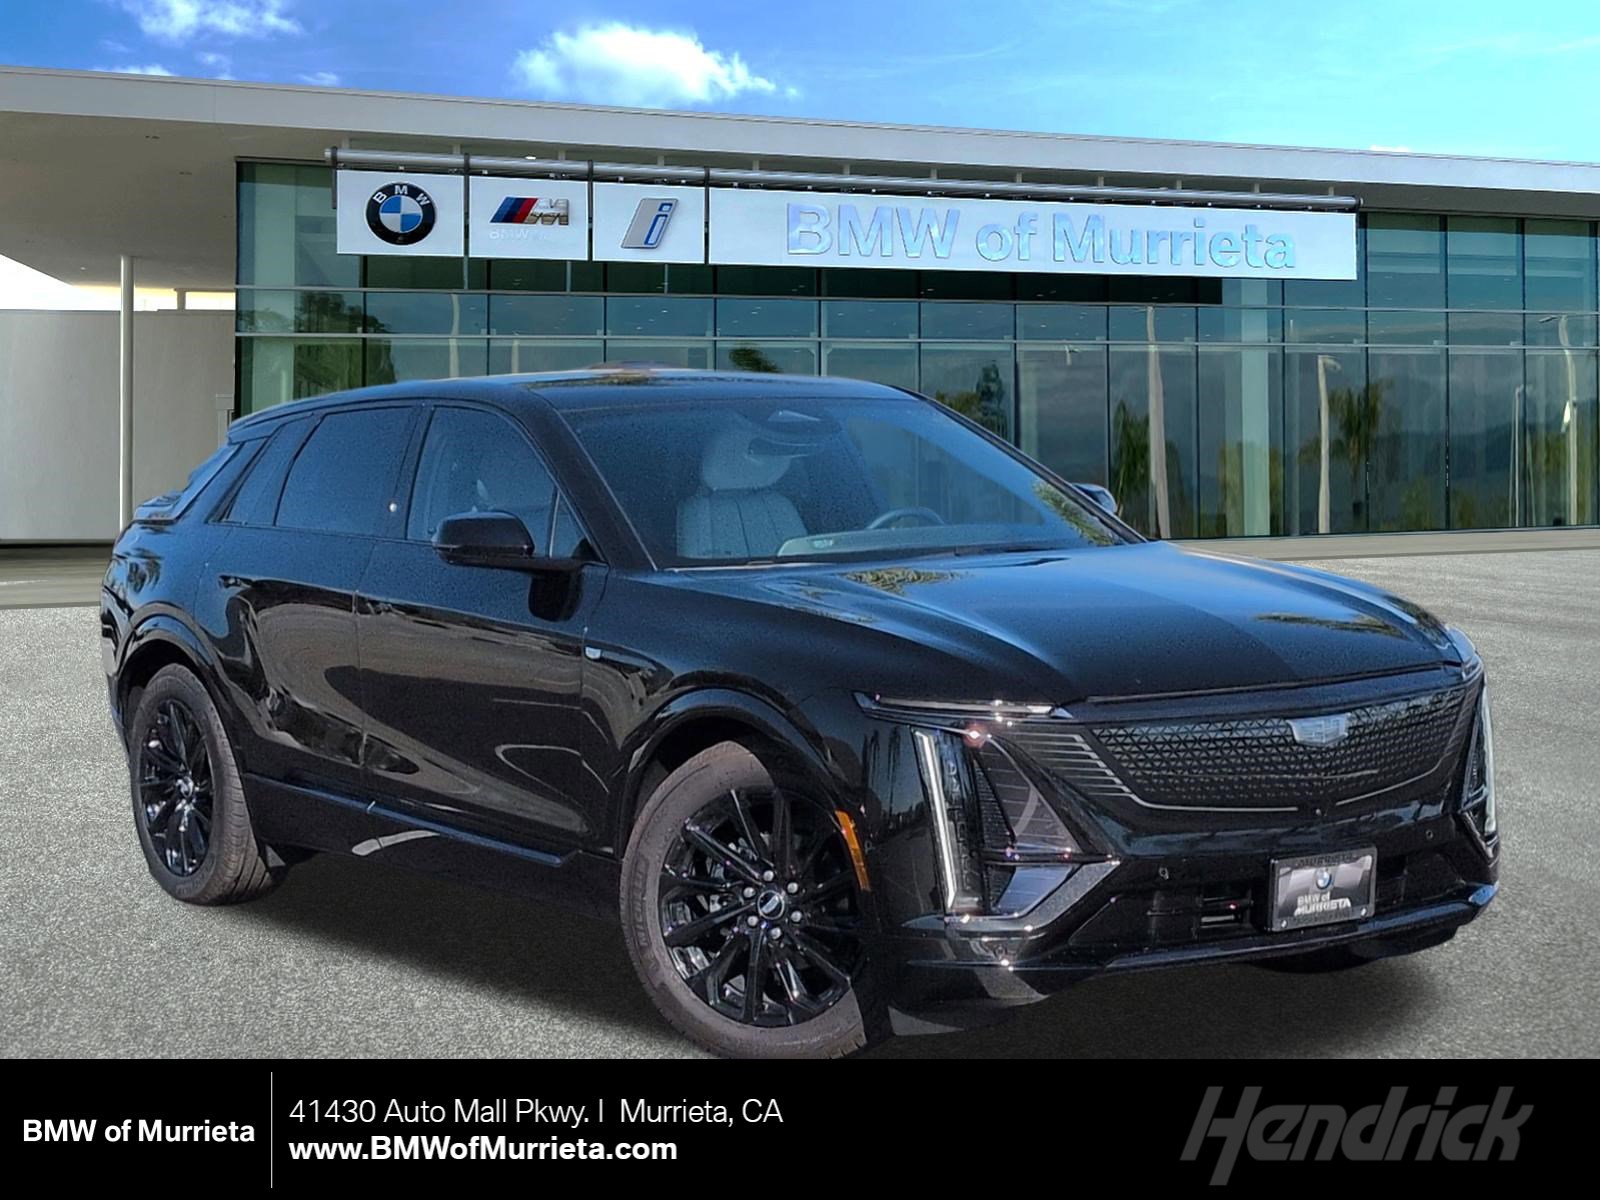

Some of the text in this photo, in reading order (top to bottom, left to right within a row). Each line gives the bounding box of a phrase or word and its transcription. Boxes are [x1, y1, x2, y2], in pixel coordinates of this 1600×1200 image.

[372, 184, 431, 206] BMW
[786, 203, 1296, 269] BMW of Murrieta
[1293, 897, 1352, 917] MURRIETA
[1297, 892, 1321, 906] BMW
